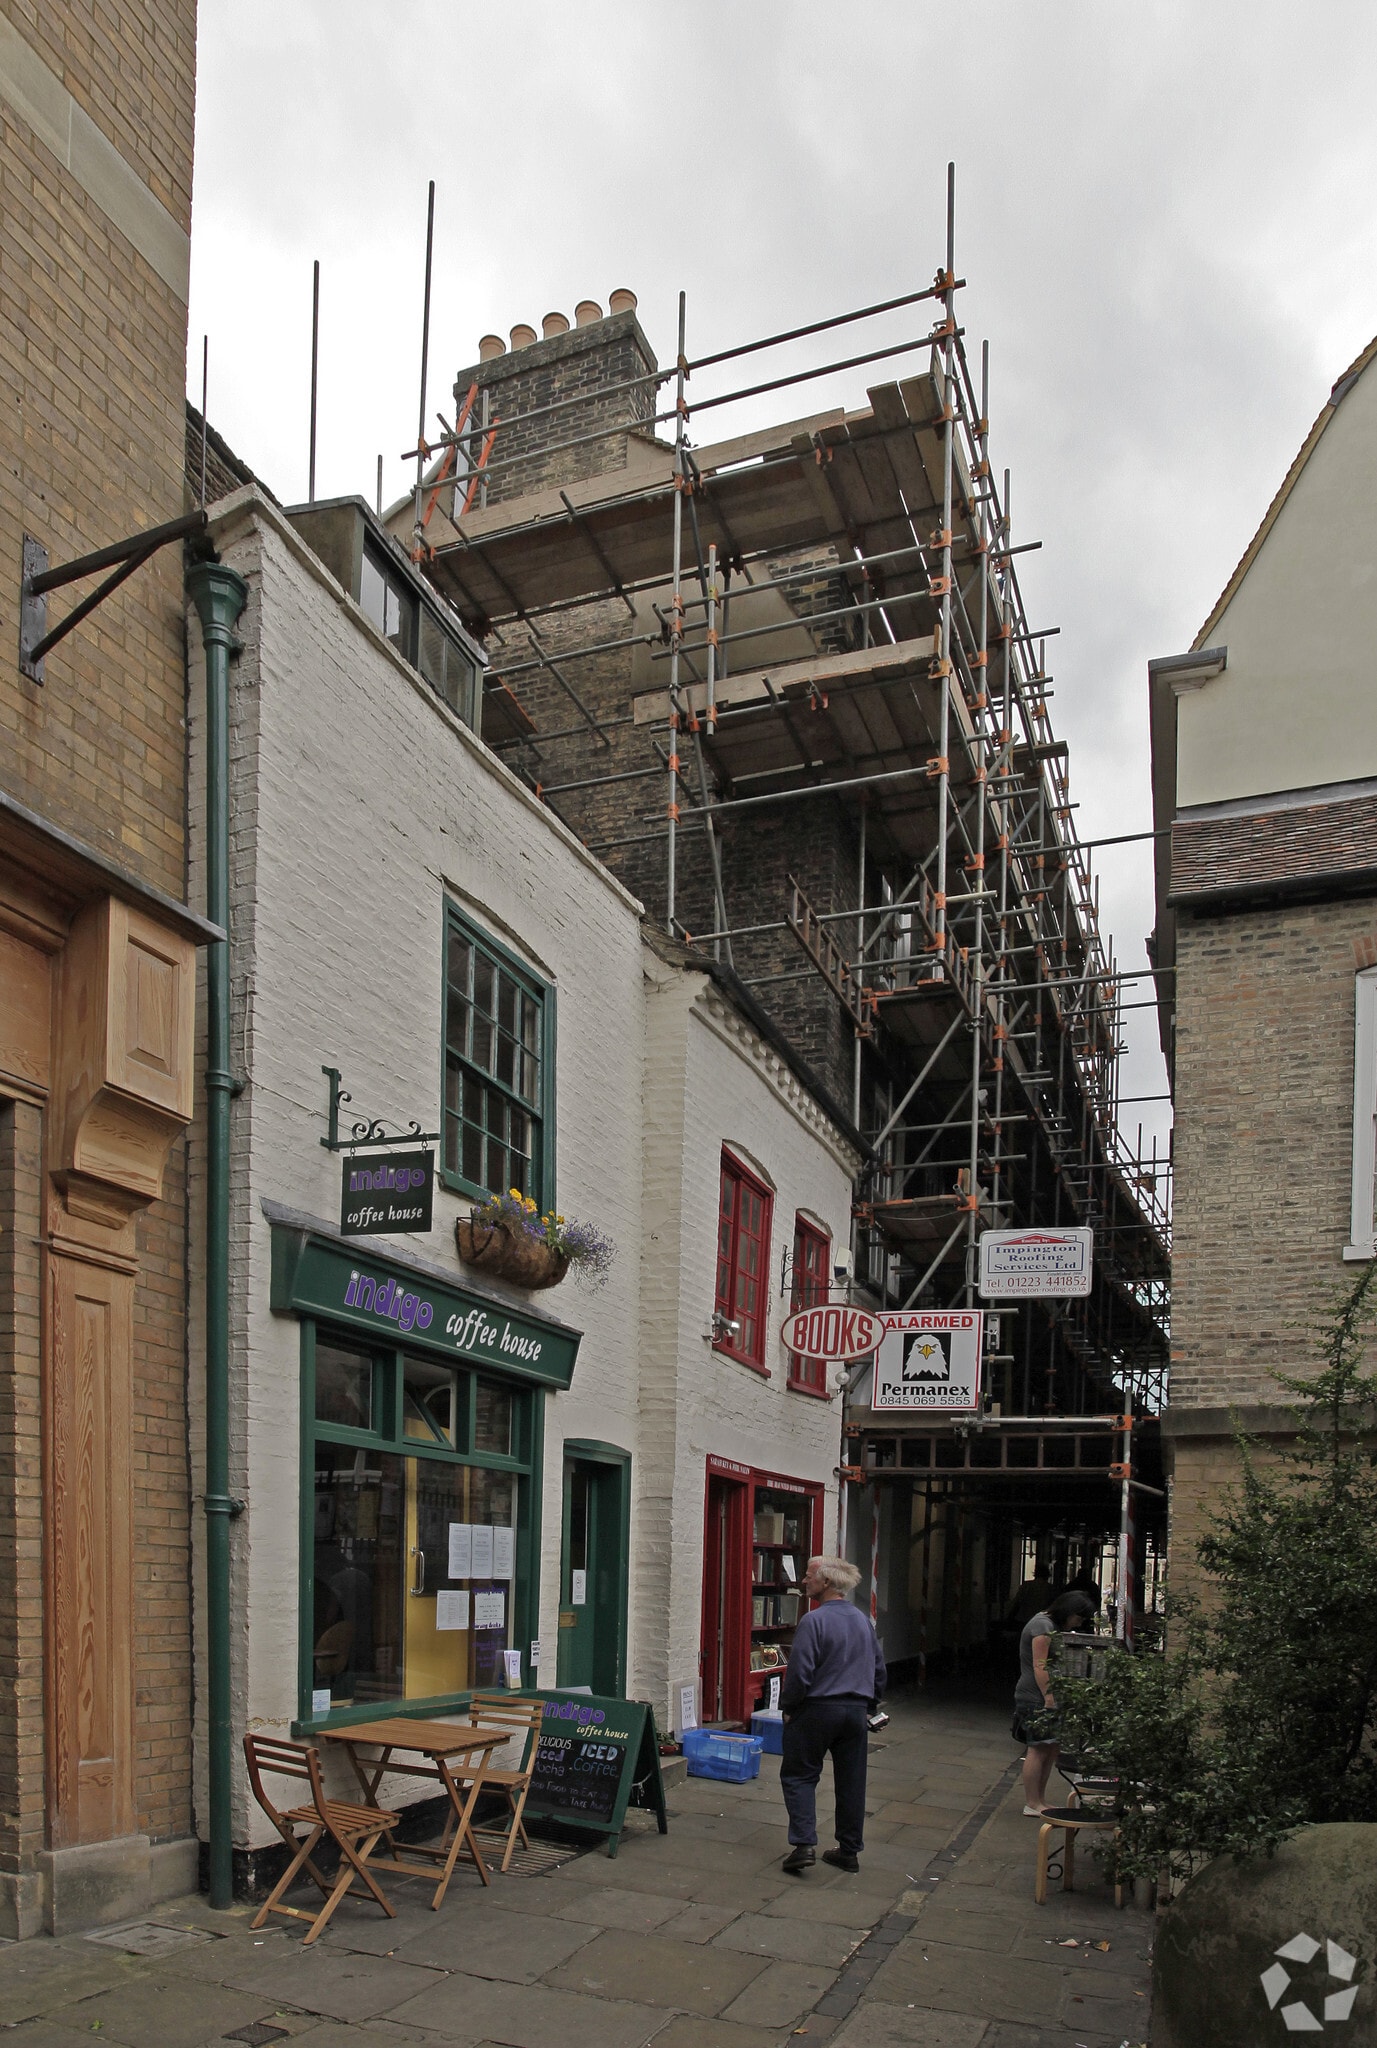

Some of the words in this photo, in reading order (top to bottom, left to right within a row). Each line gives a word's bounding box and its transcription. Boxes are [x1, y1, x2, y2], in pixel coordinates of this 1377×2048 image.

[350, 1165, 425, 1193] indigo
[347, 1206, 384, 1228] coffee
[388, 1206, 423, 1221] house
[995, 1246, 1077, 1255] Impington
[1009, 1254, 1064, 1262] Roofing
[994, 1263, 1048, 1271] Services
[986, 1279, 1004, 1288] Tel.
[1007, 1277, 1041, 1288] 01223
[1046, 1275, 1087, 1287] 441852
[344, 1270, 433, 1332] indigo
[445, 1309, 498, 1350] coffee
[499, 1321, 542, 1362] house
[885, 1315, 974, 1329] ALARMED
[793, 1309, 873, 1356] BOOKS
[881, 1382, 970, 1396] Permanex
[880, 1396, 910, 1406] 0845
[913, 1396, 937, 1406] 069
[939, 1396, 971, 1406] 5555
[576, 1725, 603, 1738] coffee
[604, 1727, 629, 1739] house
[580, 1743, 618, 1762] ICED
